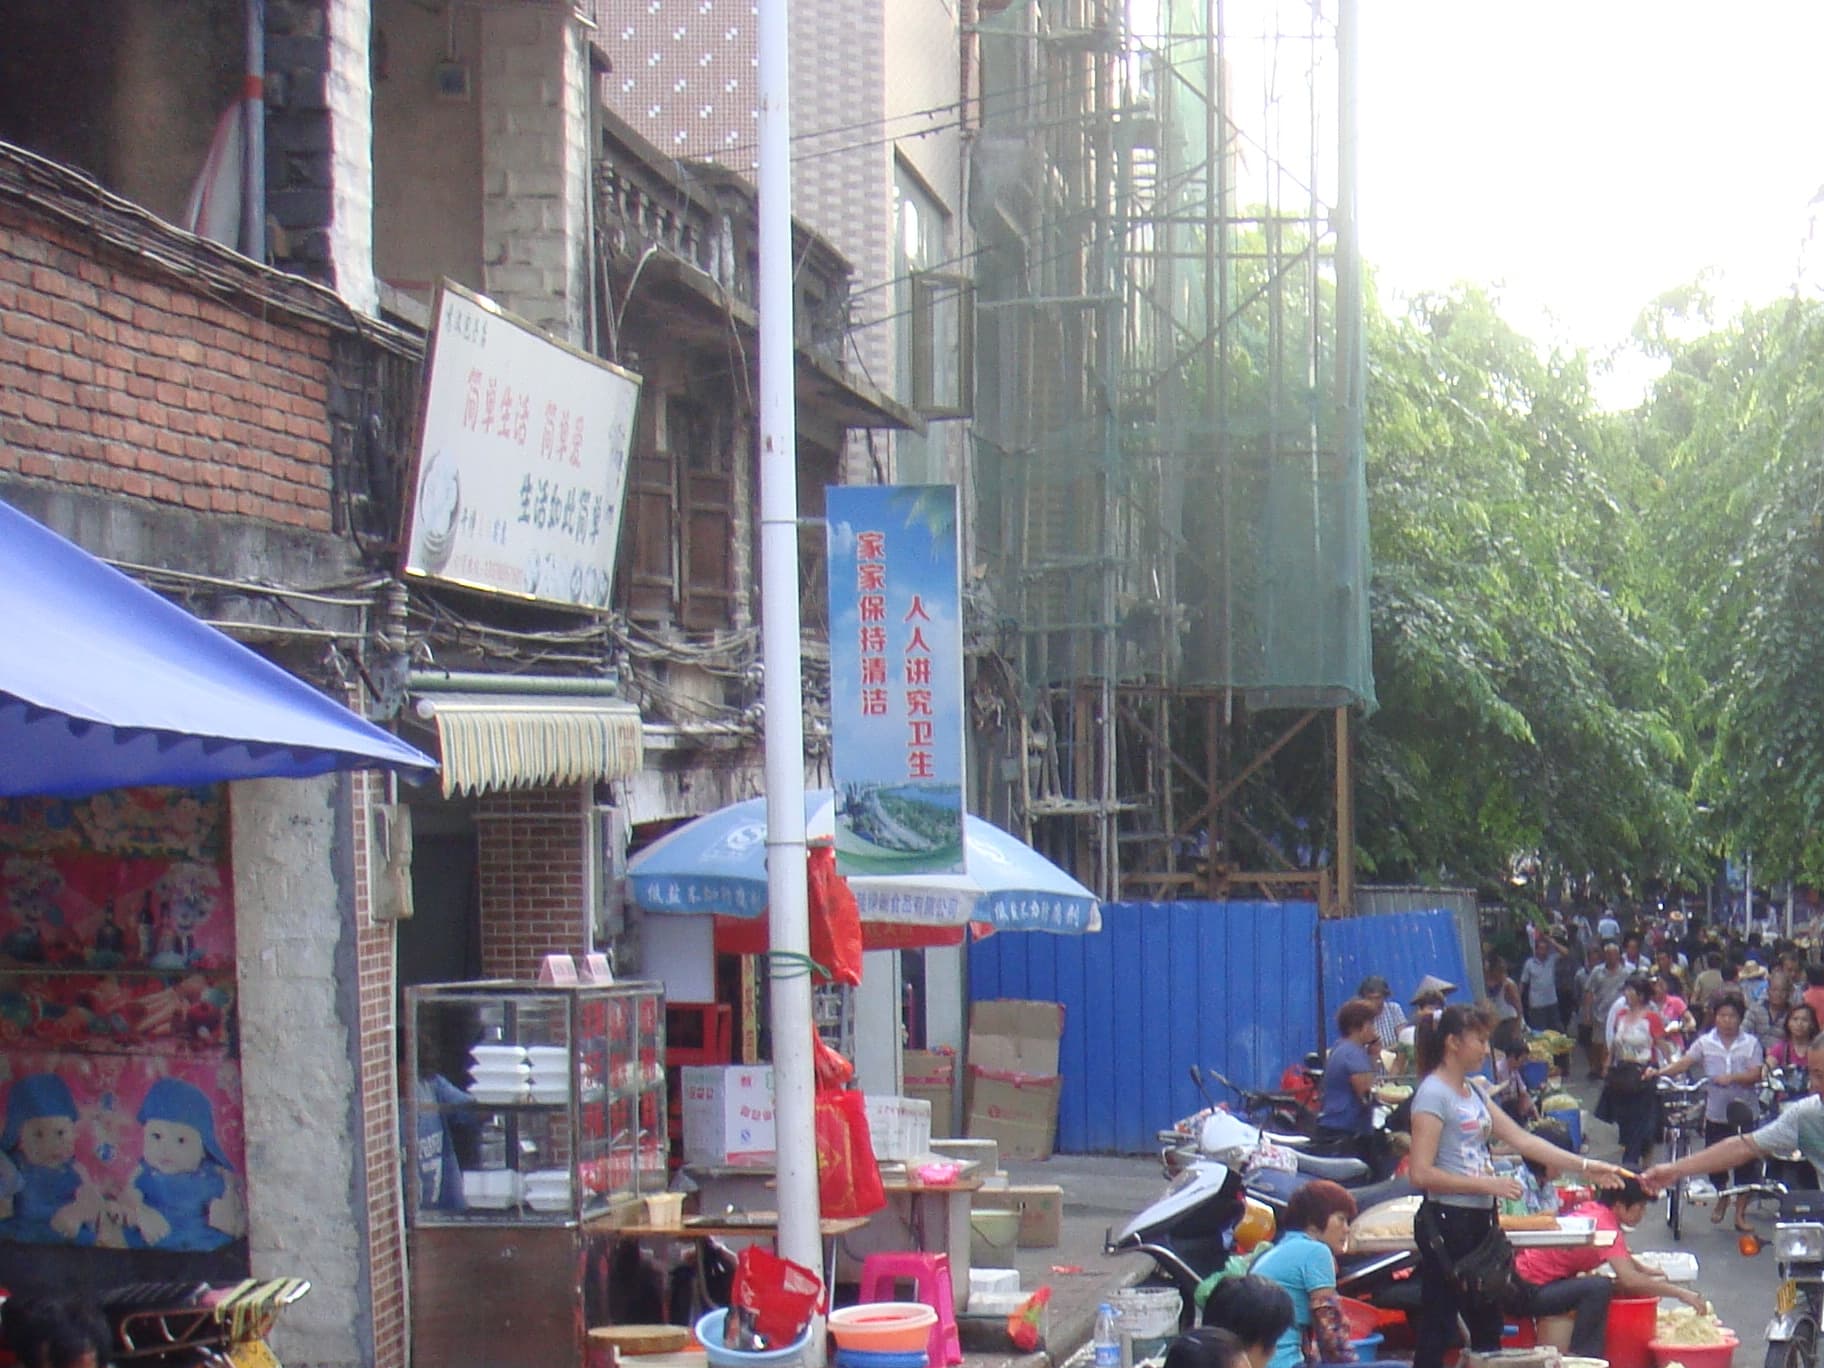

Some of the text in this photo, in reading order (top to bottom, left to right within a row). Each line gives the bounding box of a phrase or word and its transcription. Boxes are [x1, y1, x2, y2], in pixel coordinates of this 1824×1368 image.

[855, 530, 889, 717] 家家保持清洁
[903, 594, 935, 780] 人人讲究卫生
